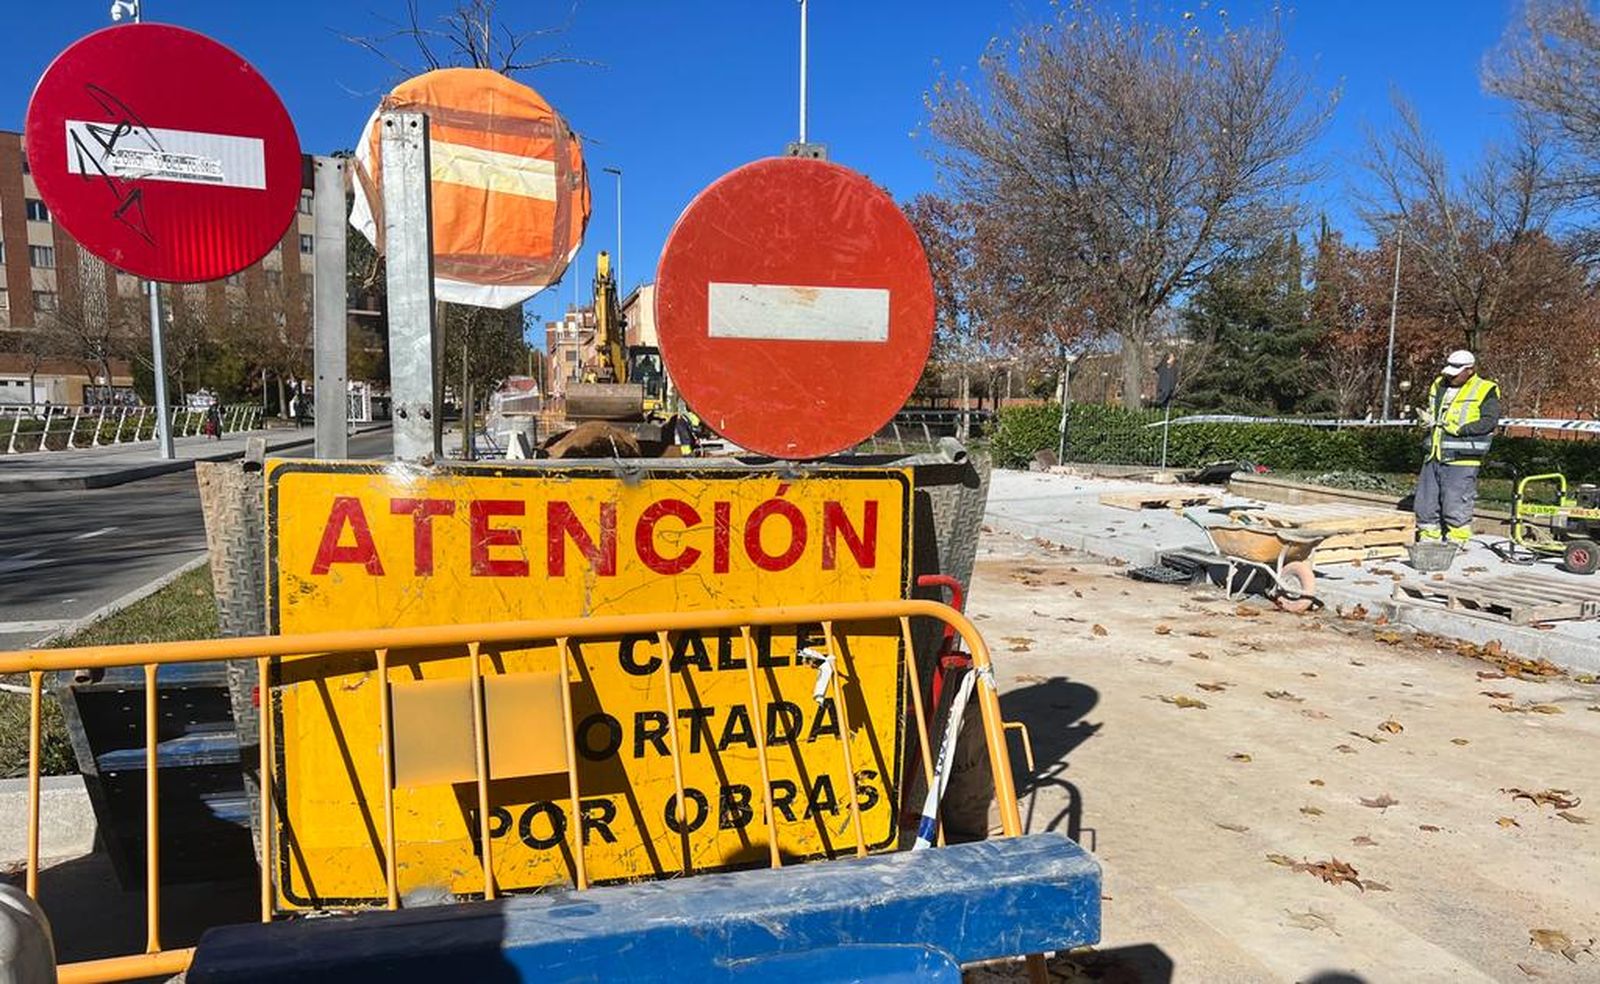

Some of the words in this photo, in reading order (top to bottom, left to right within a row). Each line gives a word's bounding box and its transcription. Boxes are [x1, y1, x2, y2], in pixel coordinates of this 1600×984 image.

[310, 483, 878, 578] ATENCIÓN
[575, 698, 842, 762] ORTADA
[470, 798, 618, 856] POR
[664, 769, 879, 835] OBRAS
